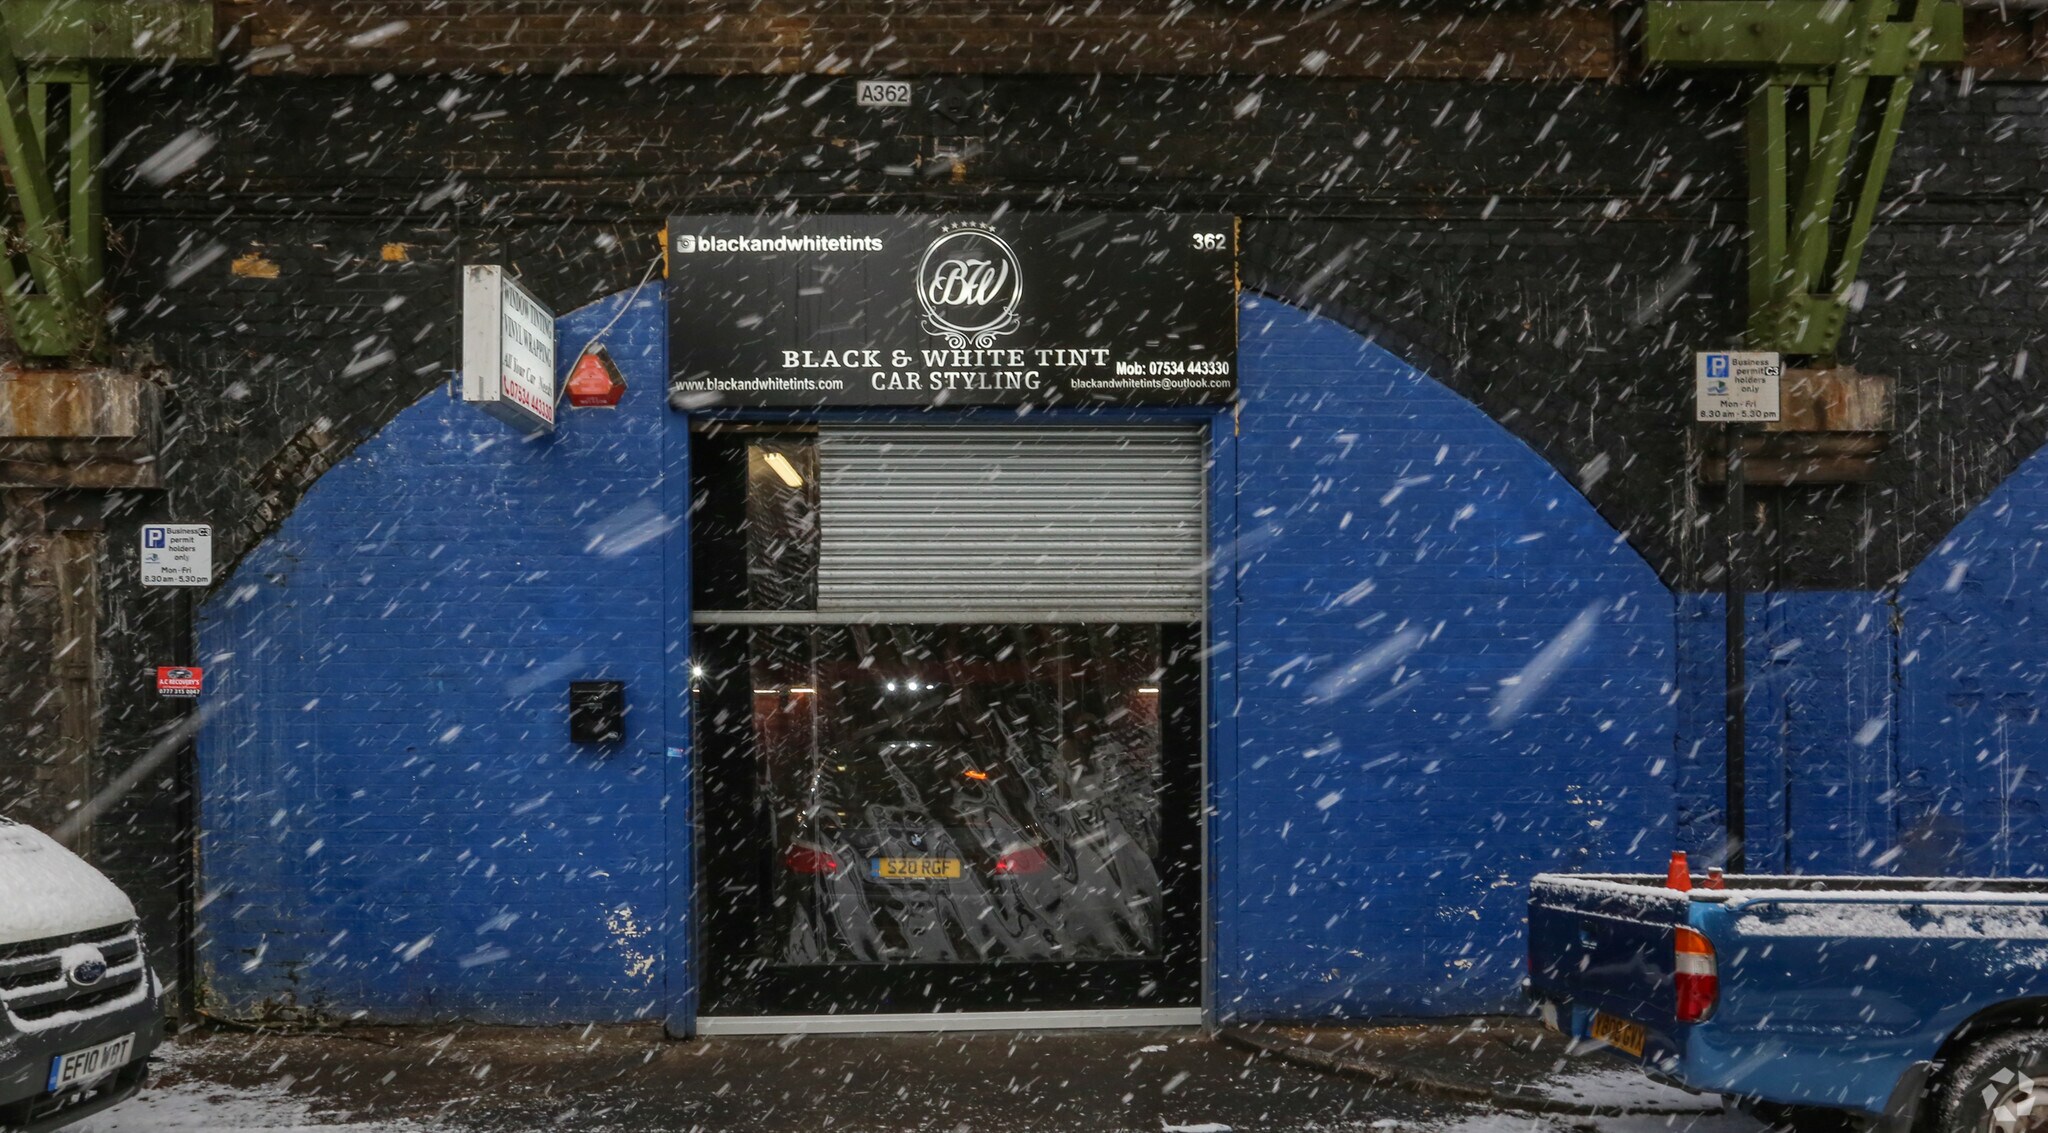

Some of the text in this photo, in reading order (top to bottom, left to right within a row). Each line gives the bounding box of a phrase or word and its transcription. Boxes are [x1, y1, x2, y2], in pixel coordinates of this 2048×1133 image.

[861, 85, 907, 102] A362
[698, 235, 883, 252] blackandwhitetints
[1192, 233, 1227, 250] 362
[503, 281, 553, 340] WINDOW TINTING
[503, 313, 552, 368] VINYL WRAPPING
[513, 356, 526, 378] Your
[781, 349, 1111, 368] BLACK & WHITE TINT
[1712, 357, 1726, 376] P
[1116, 361, 1230, 376] Mob: 07534 443330
[675, 377, 844, 391] www.blackandwhitetints.com
[871, 371, 1042, 390] CAR STYLING
[1071, 378, 1231, 390] blackandwhitetints@outlook.com
[1734, 376, 1766, 384] holders
[510, 380, 553, 421] 07534 443330
[1700, 410, 1721, 418] 8.30
[1741, 410, 1762, 418] 5.30
[149, 529, 162, 547] P
[887, 860, 951, 875] S20 RGF
[62, 1049, 99, 1082] EF10
